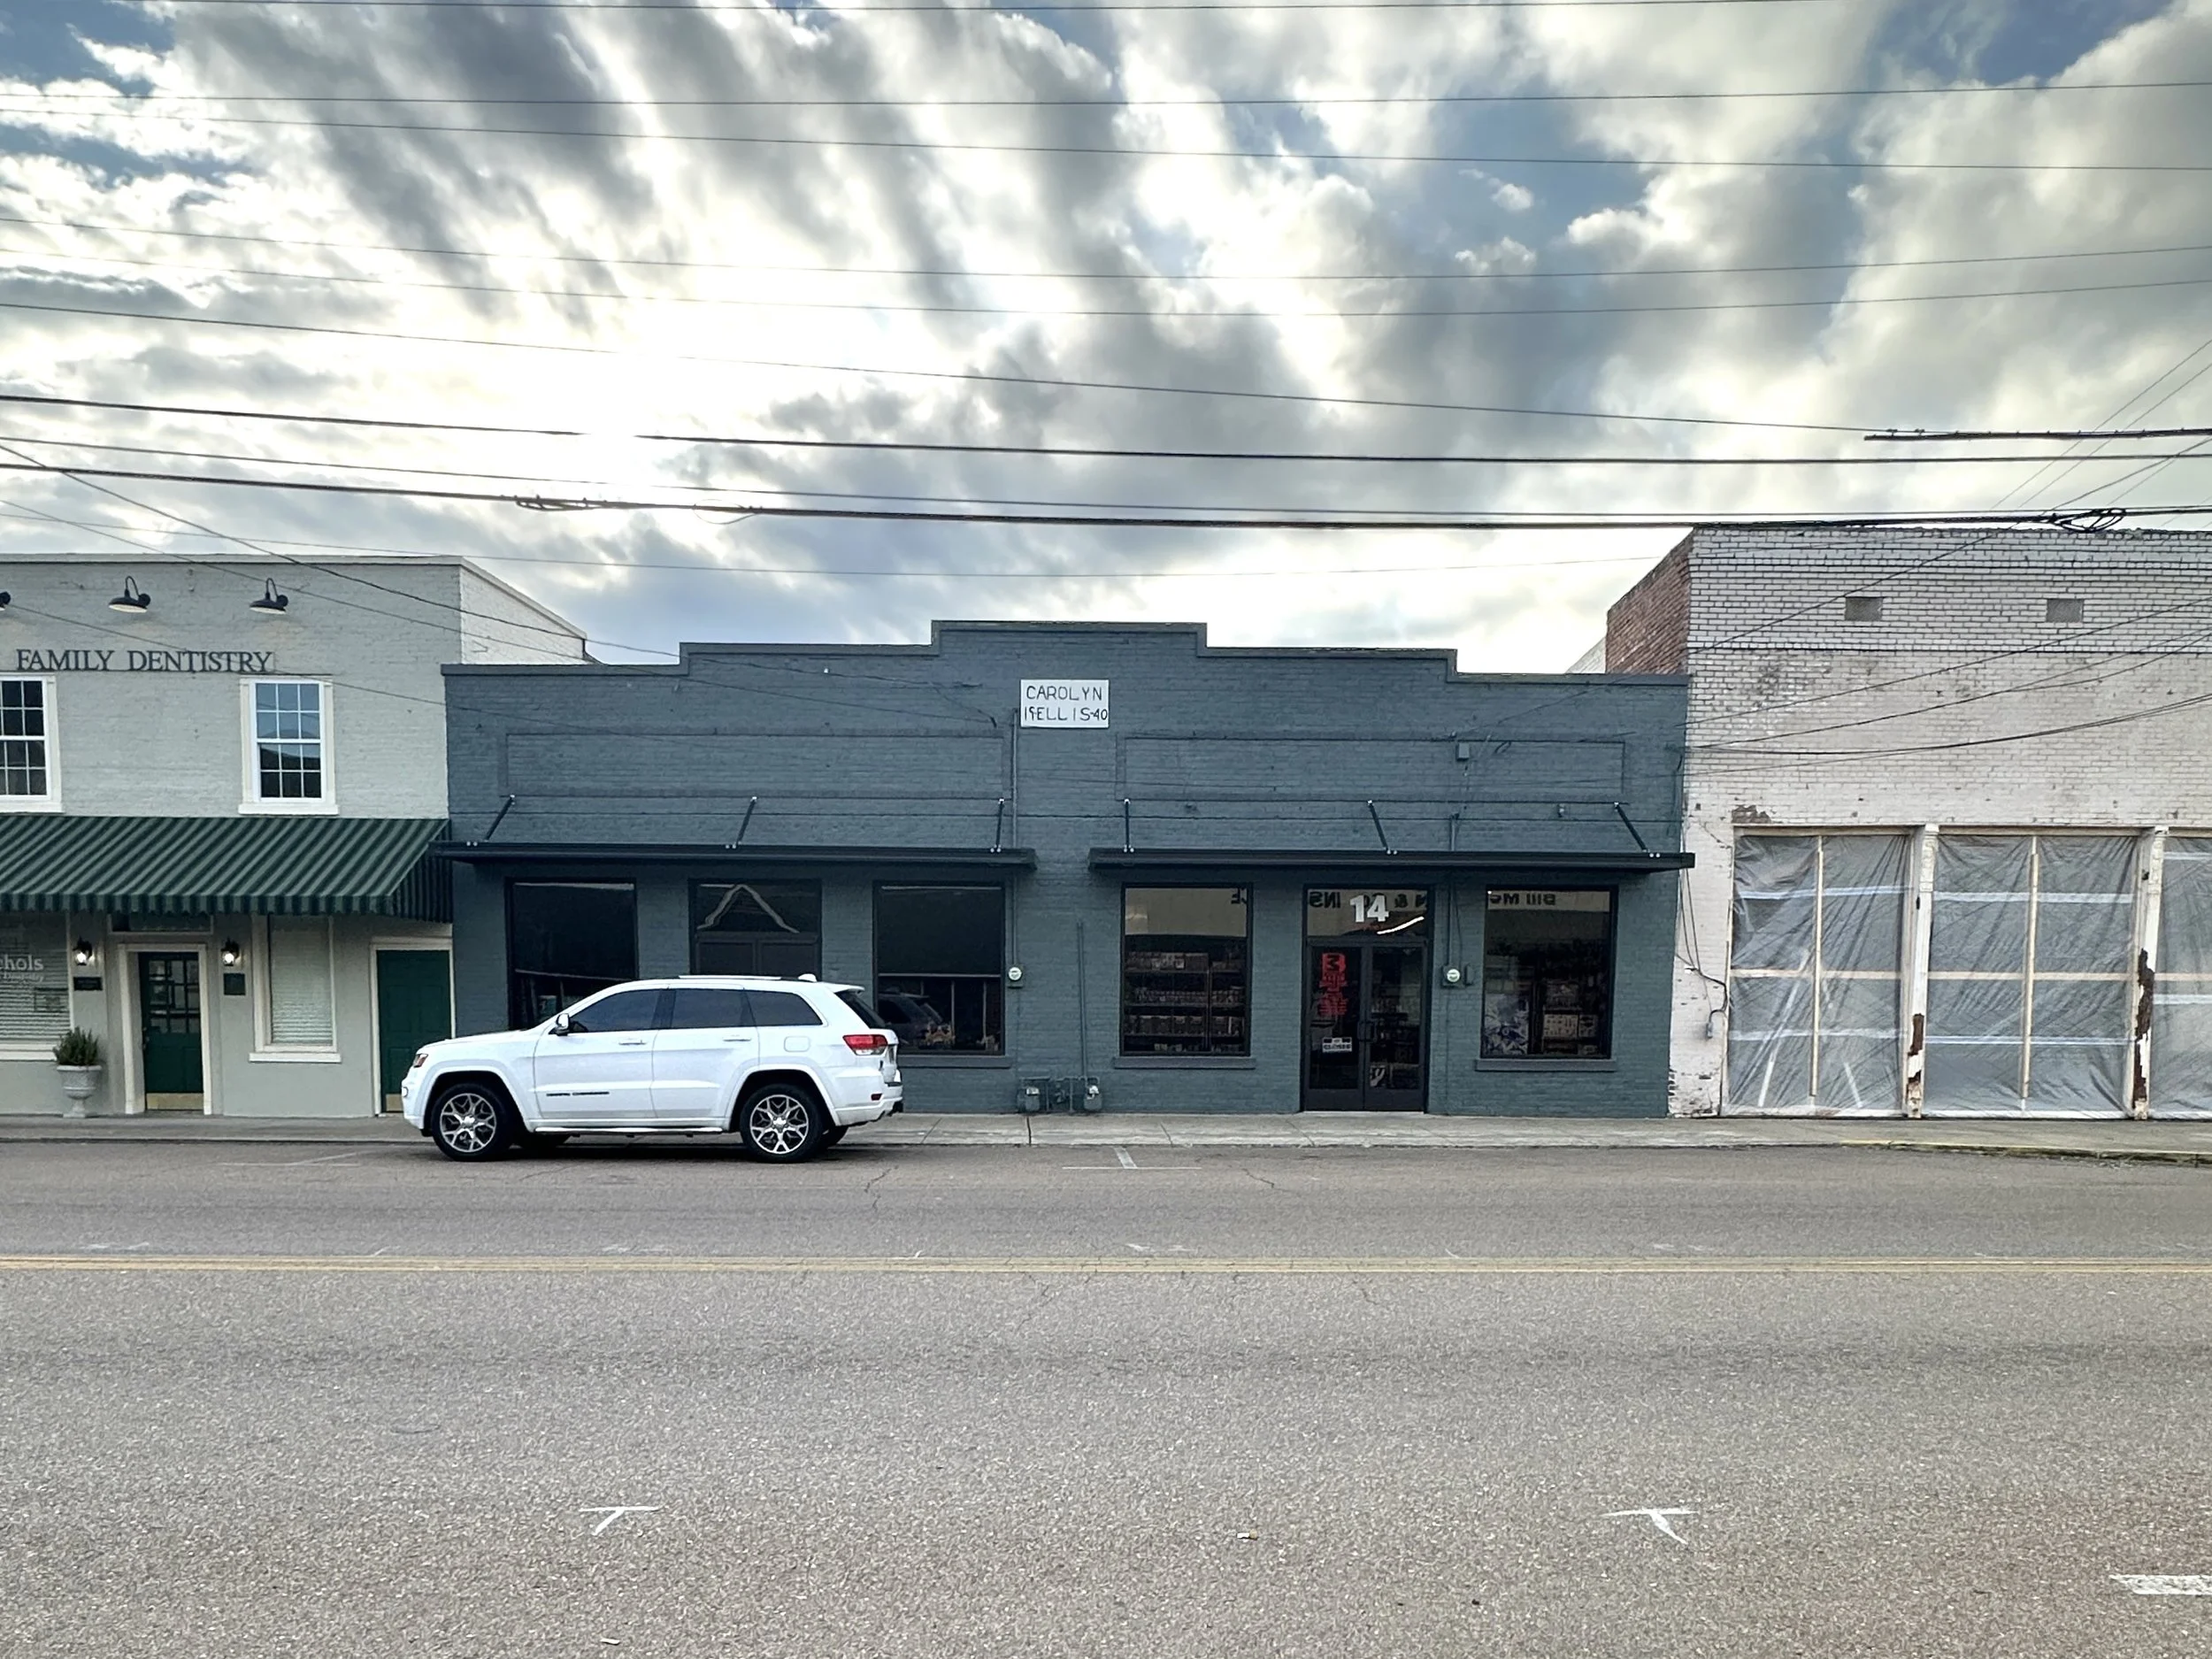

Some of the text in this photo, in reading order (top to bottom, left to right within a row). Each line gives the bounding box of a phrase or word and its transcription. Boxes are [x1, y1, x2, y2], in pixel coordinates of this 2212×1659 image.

[16, 649, 273, 673] FAMILY DENTISTRY
[1026, 685, 1102, 701] CAROLYN
[1349, 895, 1389, 923] 14
